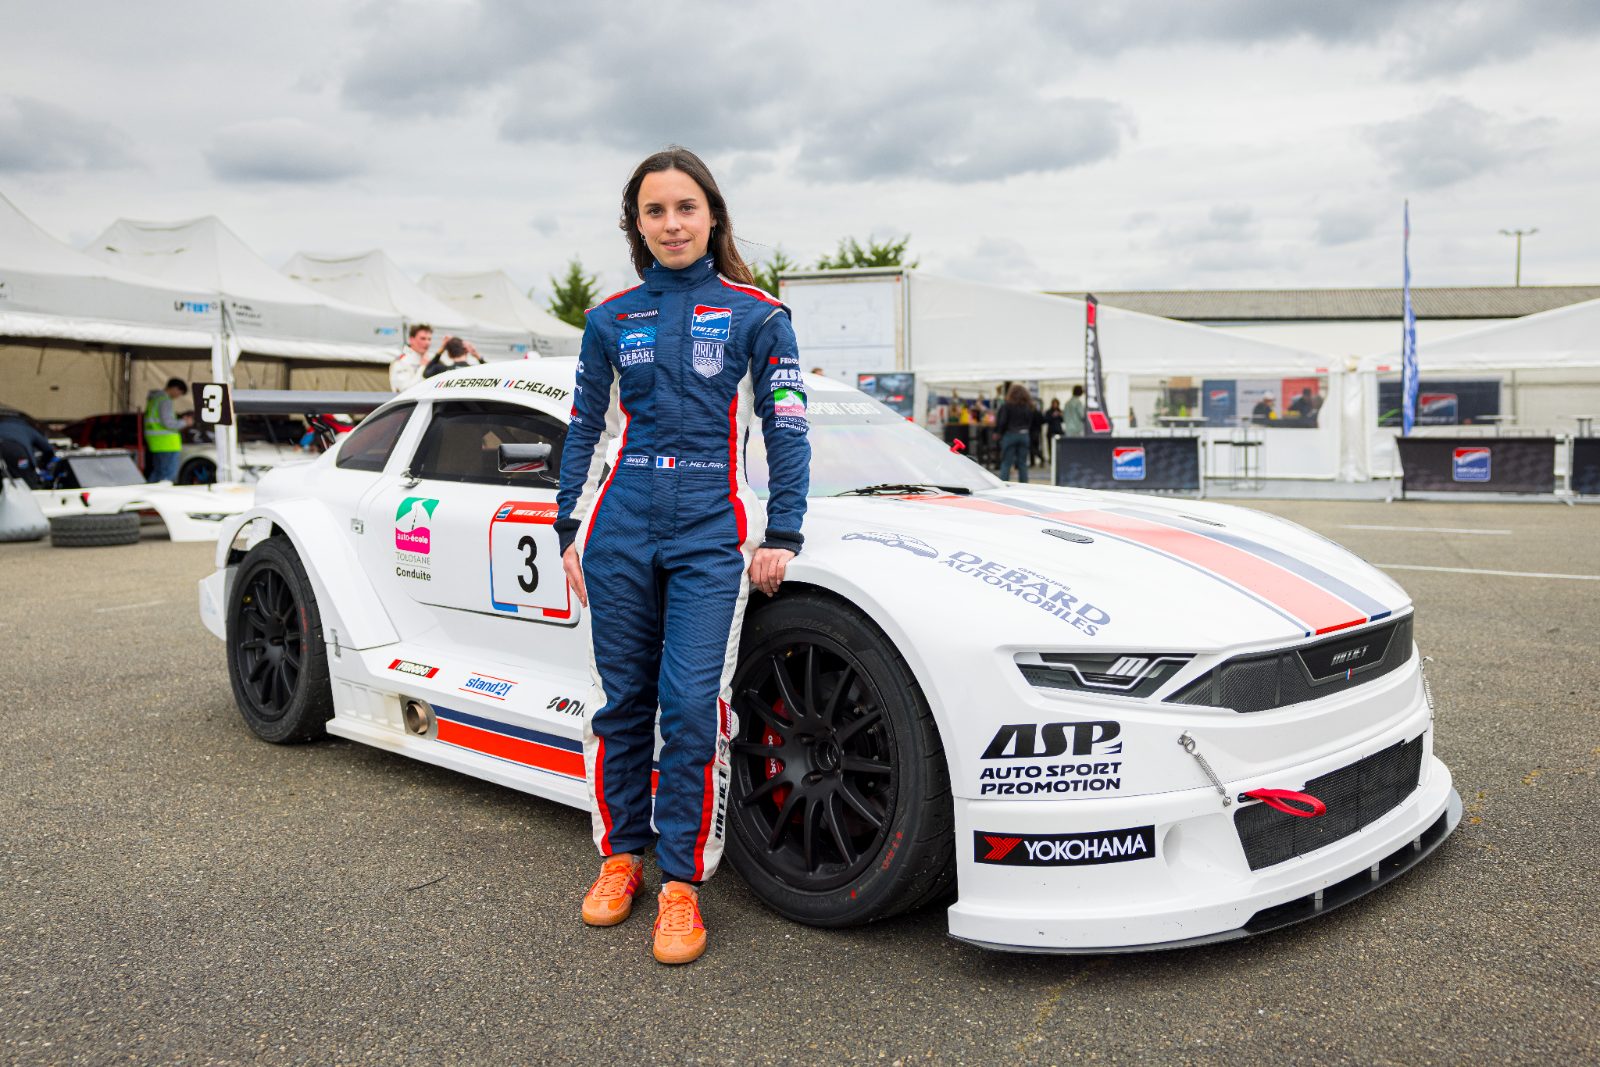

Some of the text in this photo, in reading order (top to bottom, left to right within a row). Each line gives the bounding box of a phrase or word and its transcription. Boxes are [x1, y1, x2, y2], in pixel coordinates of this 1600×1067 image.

[627, 310, 659, 319] YOKOHAMA
[202, 384, 223, 424] 3
[397, 532, 429, 544] auto-école
[396, 567, 432, 581] Conduite
[517, 535, 539, 593] 3
[938, 560, 1099, 636] AUTOMOBILES
[949, 551, 1111, 626] DEBARD
[465, 677, 512, 697] stand21
[980, 720, 1121, 760] ASP
[980, 762, 1122, 779] AUTO SPORT
[980, 778, 1121, 795] PROMOTION
[1023, 833, 1147, 861] YOKOHAMA
